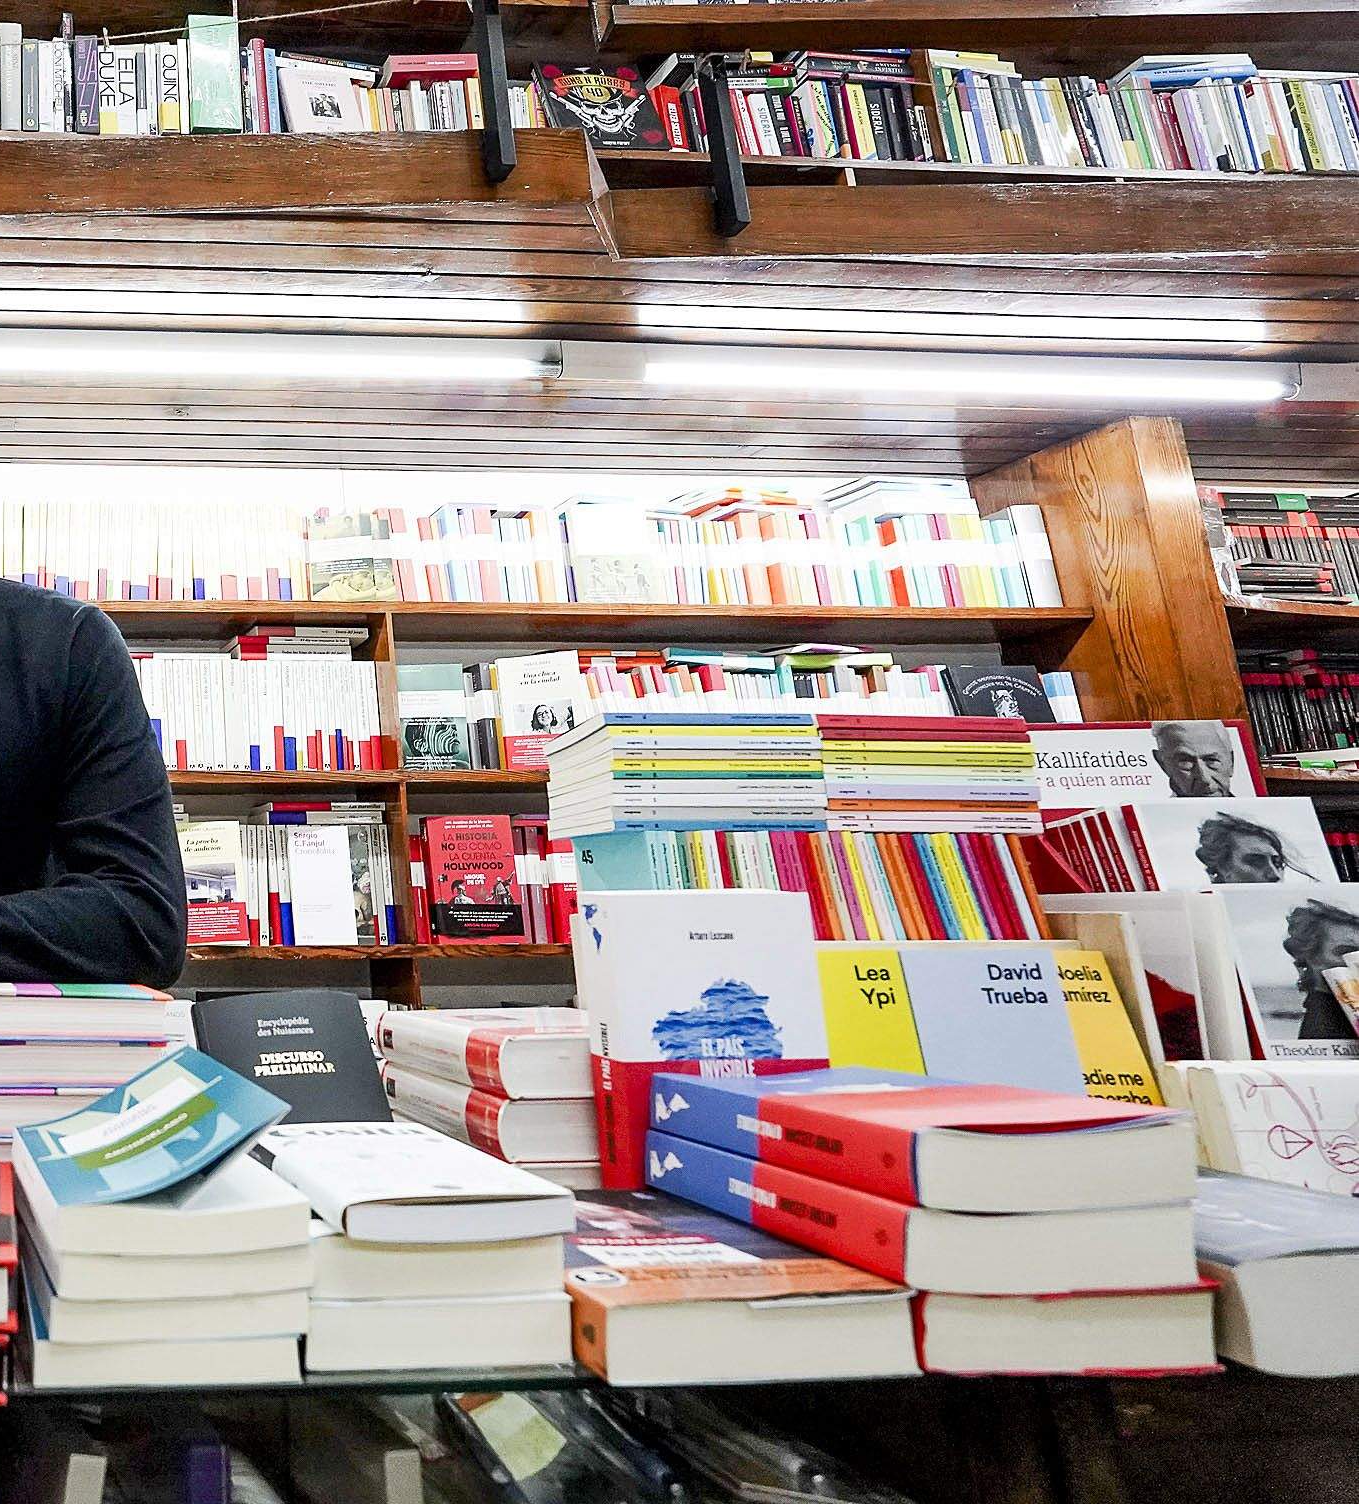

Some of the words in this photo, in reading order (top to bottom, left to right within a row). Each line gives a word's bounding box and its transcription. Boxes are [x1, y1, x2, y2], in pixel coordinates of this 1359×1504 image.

[99, 52, 116, 107] DUKE
[118, 58, 135, 106] ELLA
[554, 76, 581, 89] GUNS
[594, 76, 626, 89] ROSES
[757, 107, 772, 137] SIDERAL
[870, 103, 884, 135] SIDERAL
[1036, 751, 1148, 770] Kallifatides
[1047, 778, 1056, 788] a
[1061, 774, 1106, 791] quien
[1110, 775, 1153, 787] amar
[186, 838, 194, 846] La
[195, 838, 219, 847] prueba
[293, 832, 318, 841] Sergio
[443, 833, 454, 841] LA
[455, 832, 498, 840] HISTORIA
[441, 843, 455, 851] NO
[457, 843, 468, 851] ES
[469, 842, 502, 850] COMO
[449, 853, 460, 861] LA
[461, 852, 496, 861] CUENTA
[581, 849, 593, 863] 45
[443, 862, 504, 871] HOLLYWOOD
[854, 965, 890, 982] Lea
[988, 963, 1042, 981] David
[860, 988, 896, 1010] Ypi
[981, 987, 1048, 1004] Trueba
[257, 1018, 311, 1029] Encyclopédie
[257, 1028, 271, 1037] des
[273, 1026, 315, 1037] Nuisances
[717, 1038, 746, 1056] PAÍS
[1271, 1045, 1328, 1057] Theodor
[259, 1051, 325, 1065] DISCURSO
[602, 1056, 613, 1077] PAÍS
[254, 1062, 336, 1077] PRELIMINAR
[699, 1060, 756, 1078] INVISIBLE
[1083, 1070, 1115, 1087] adie
[1119, 1073, 1144, 1087] me
